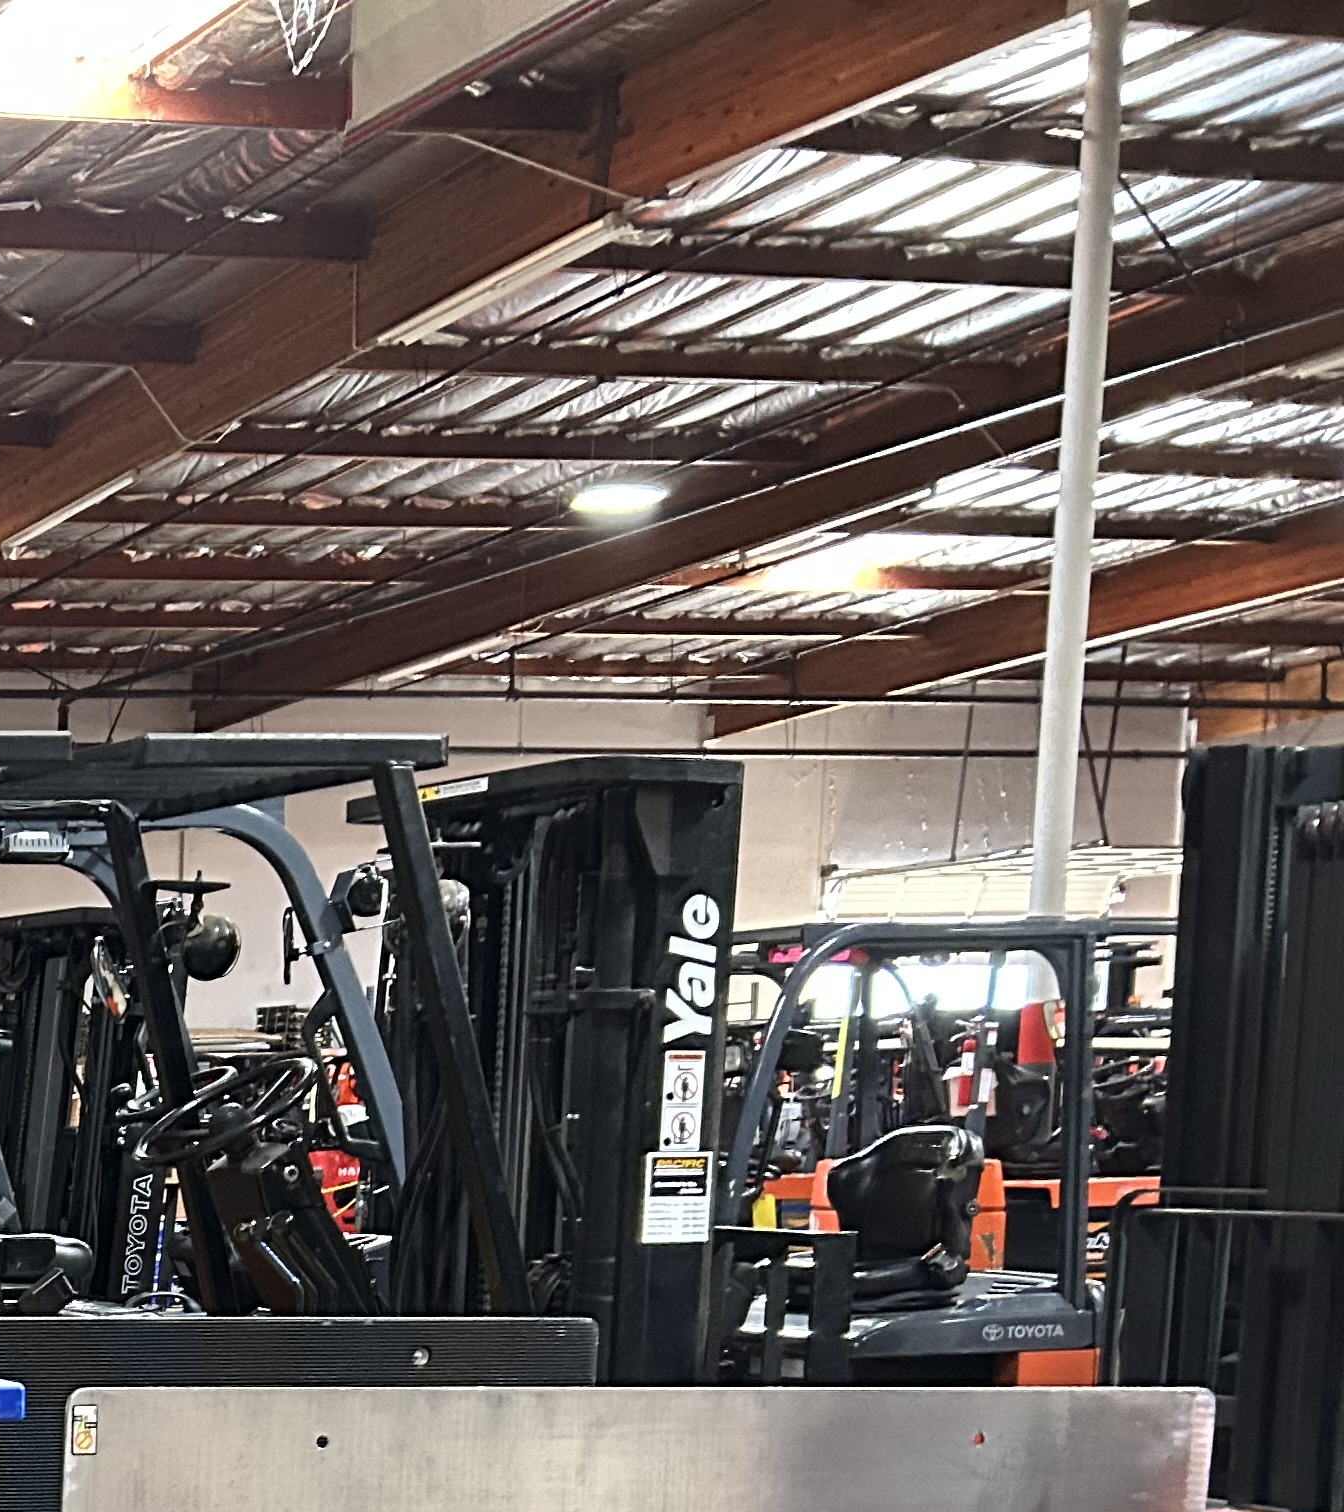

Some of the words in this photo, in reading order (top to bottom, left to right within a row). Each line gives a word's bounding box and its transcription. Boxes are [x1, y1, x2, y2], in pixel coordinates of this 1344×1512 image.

[663, 893, 720, 1044] Yale
[121, 1173, 154, 1294] TOYOTA
[1007, 1324, 1064, 1338] TOYOTA
